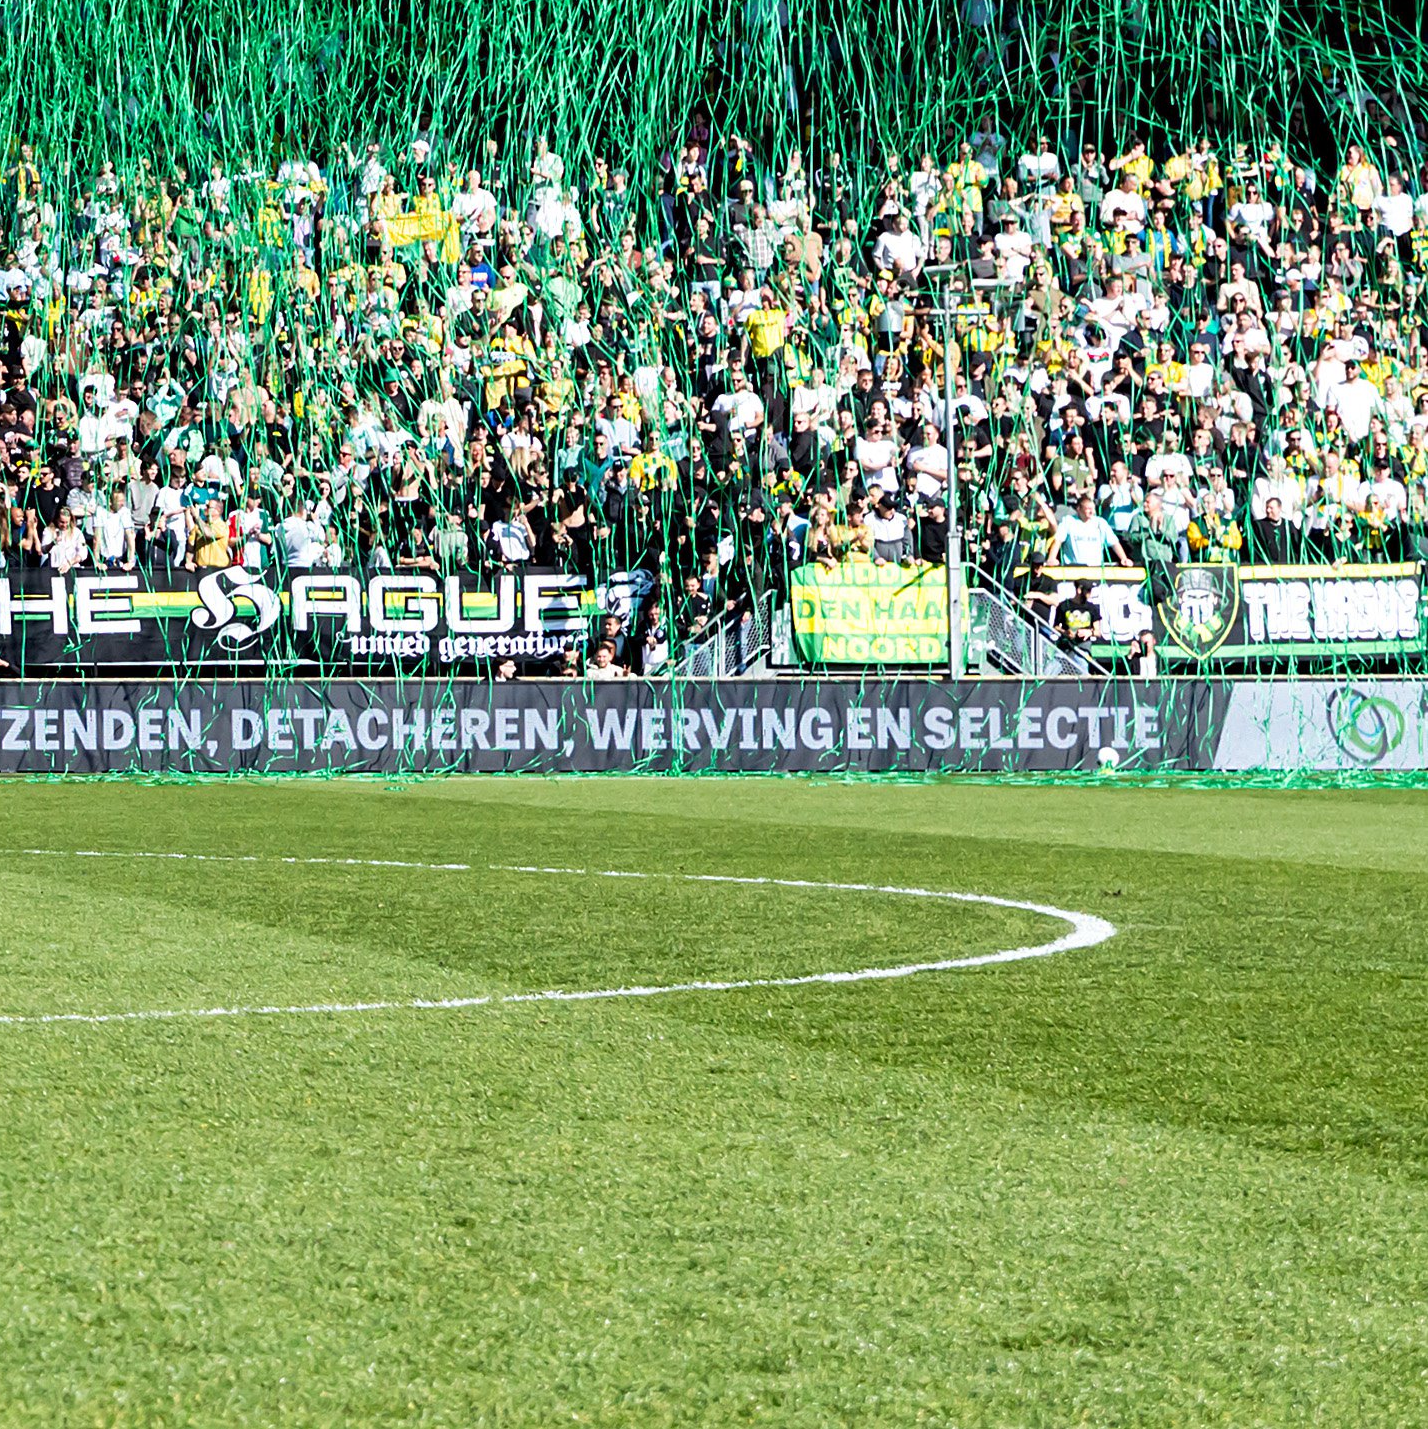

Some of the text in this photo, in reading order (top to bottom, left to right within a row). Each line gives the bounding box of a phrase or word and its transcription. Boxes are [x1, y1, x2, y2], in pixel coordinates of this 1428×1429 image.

[796, 599, 965, 620] DEN HAA
[822, 636, 941, 660] NOORD
[231, 708, 575, 758] DETACHEREN,
[586, 707, 834, 751] WERVING
[846, 706, 911, 750] EN
[922, 705, 1161, 750] SELECTIE
